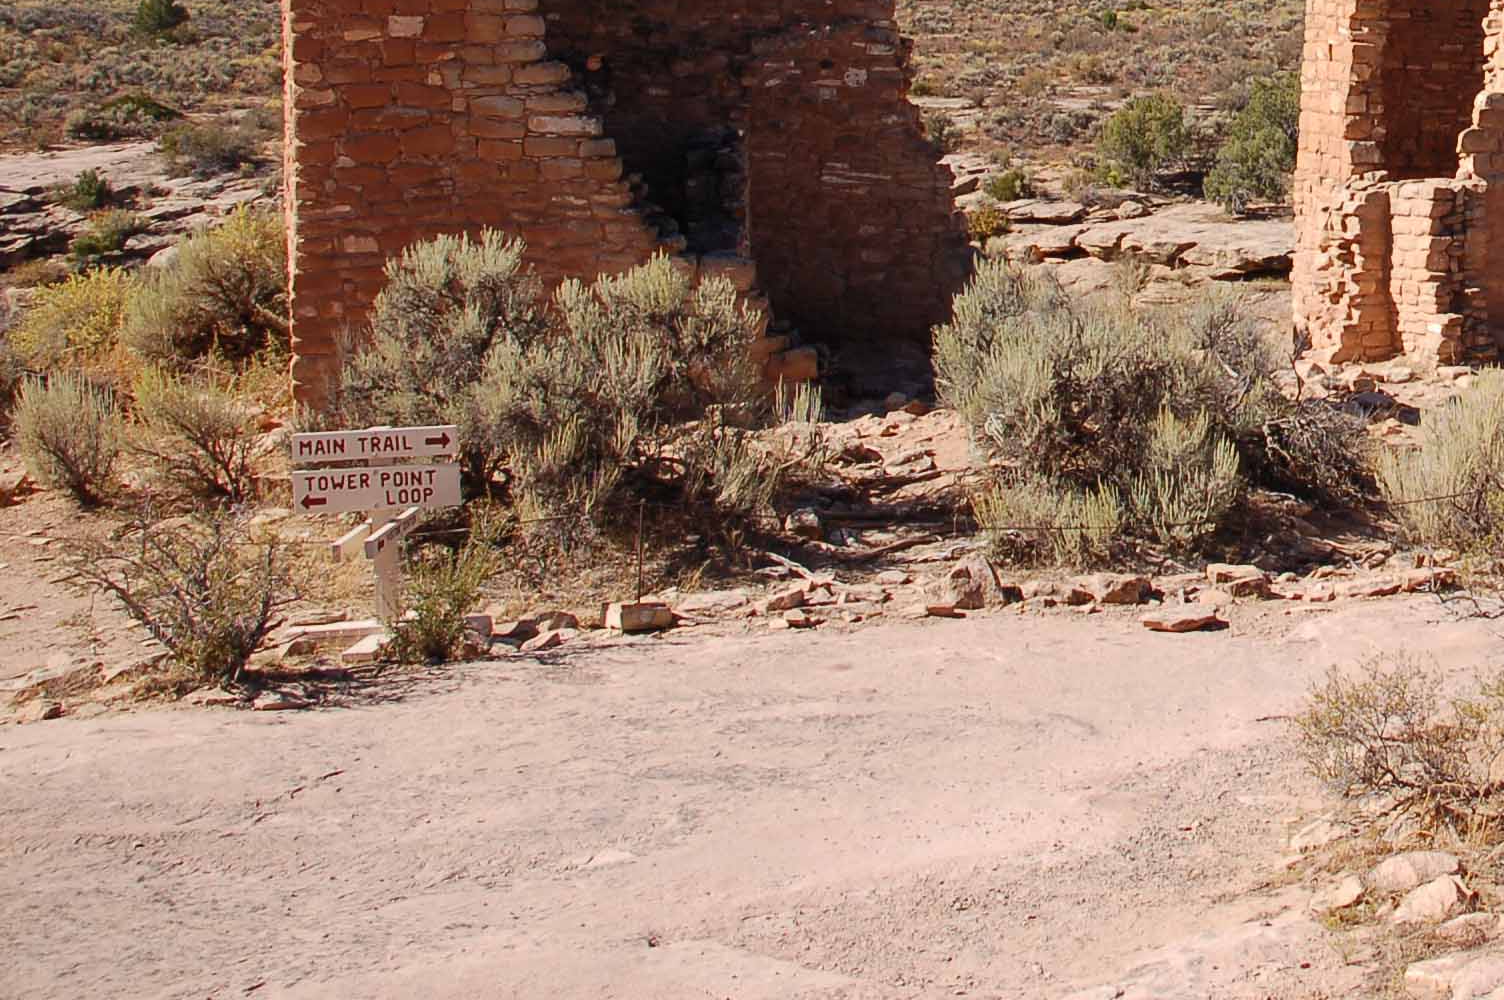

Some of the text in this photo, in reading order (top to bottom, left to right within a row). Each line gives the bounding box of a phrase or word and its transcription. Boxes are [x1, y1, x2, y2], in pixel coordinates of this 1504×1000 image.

[299, 436, 413, 456] MAIN TRAIL
[304, 469, 437, 492] TOWER POINT
[386, 487, 434, 506] LOOP
